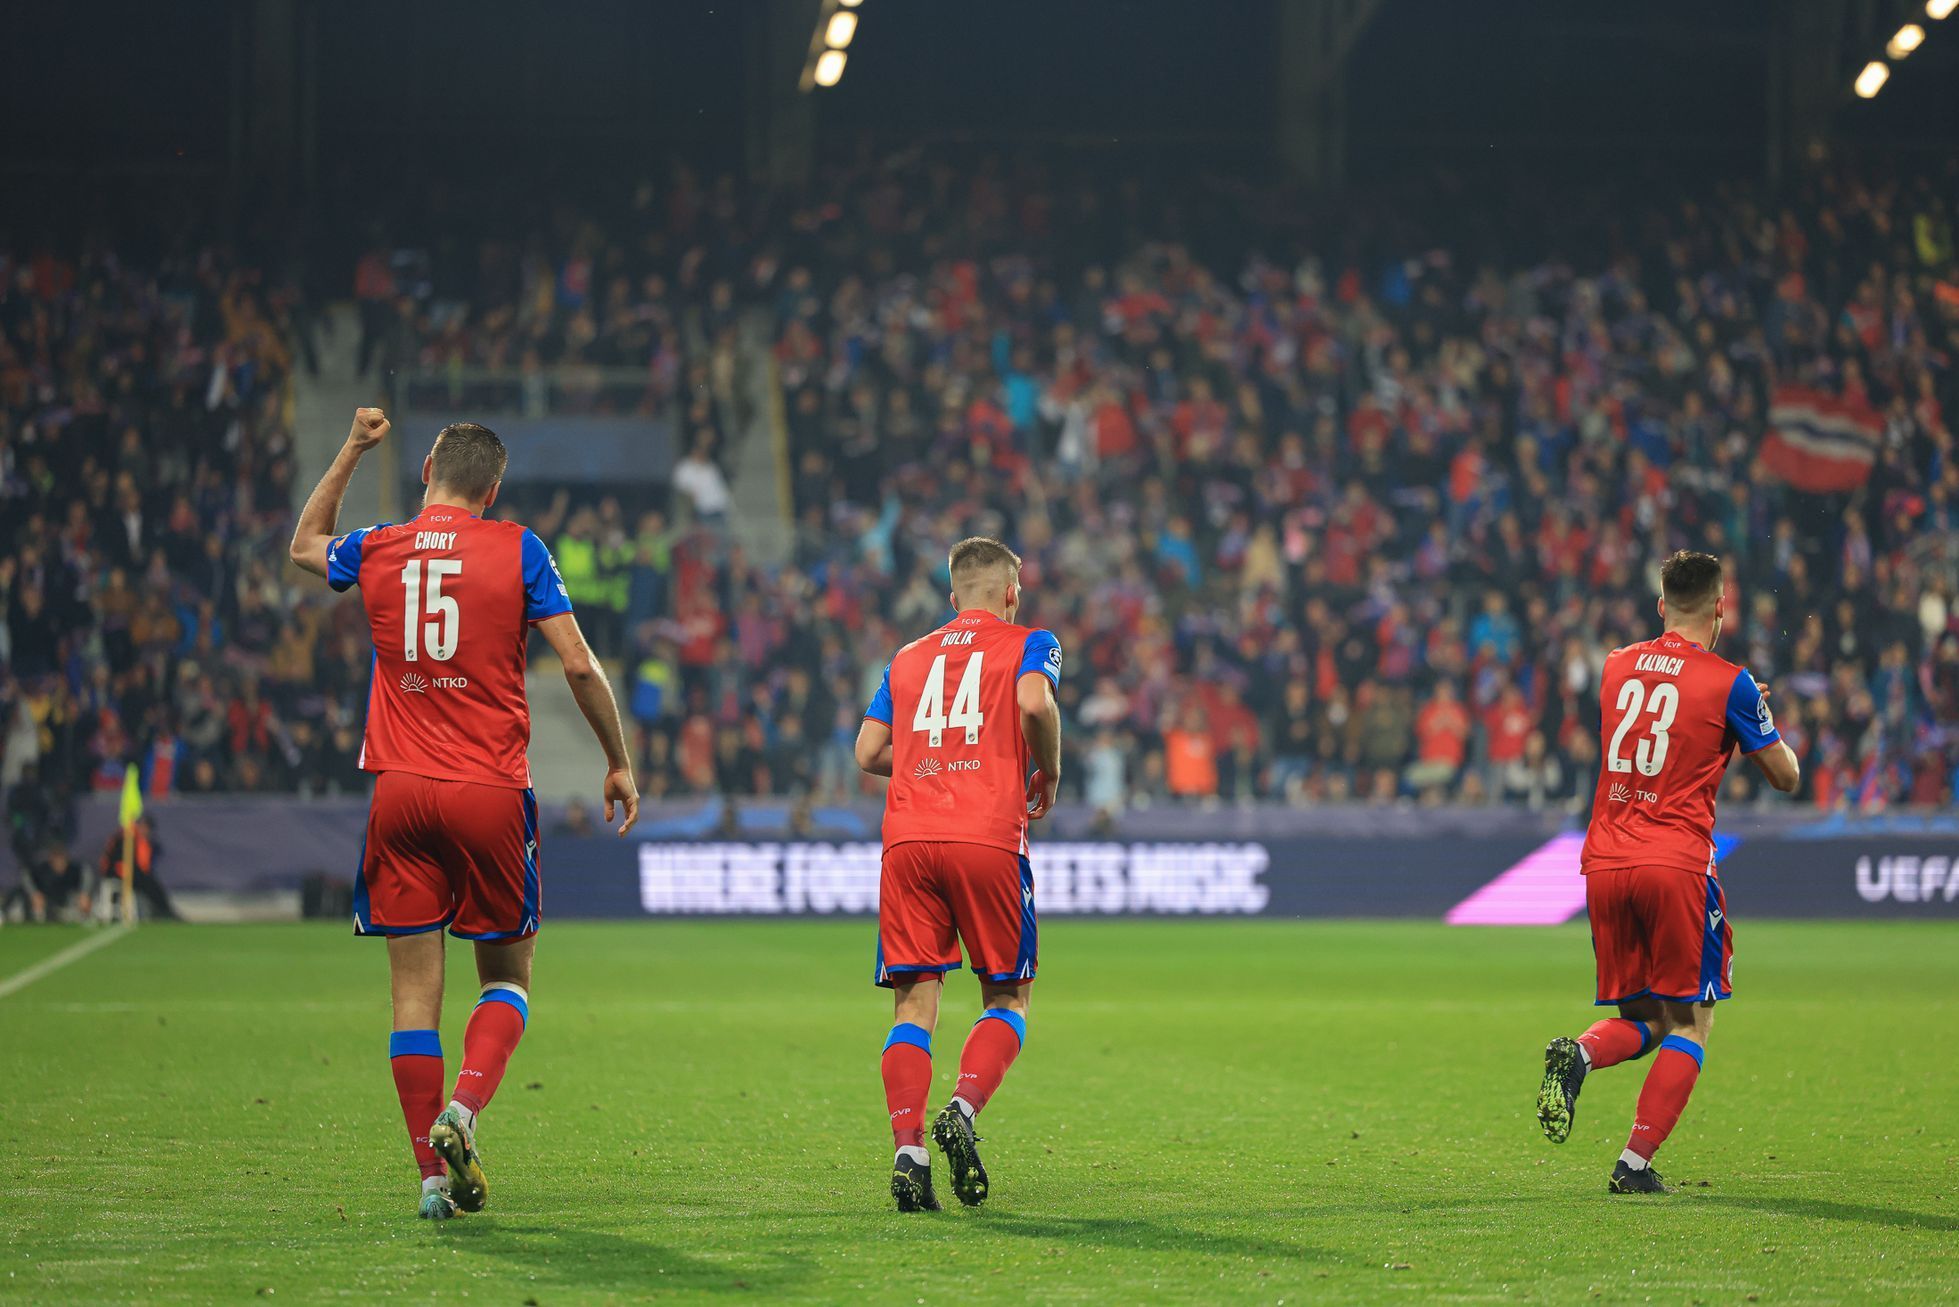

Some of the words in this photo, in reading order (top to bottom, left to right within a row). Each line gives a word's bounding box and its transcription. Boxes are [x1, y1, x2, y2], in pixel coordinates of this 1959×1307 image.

[401, 559, 462, 662] 15
[1634, 653, 1685, 676] KALVACH
[432, 677, 468, 689] NTKD
[912, 651, 984, 748] 44
[1607, 678, 1679, 777] 23
[947, 759, 981, 773] NTKD
[958, 1072, 978, 1080] CVP
[1632, 1123, 1650, 1131] CVP
